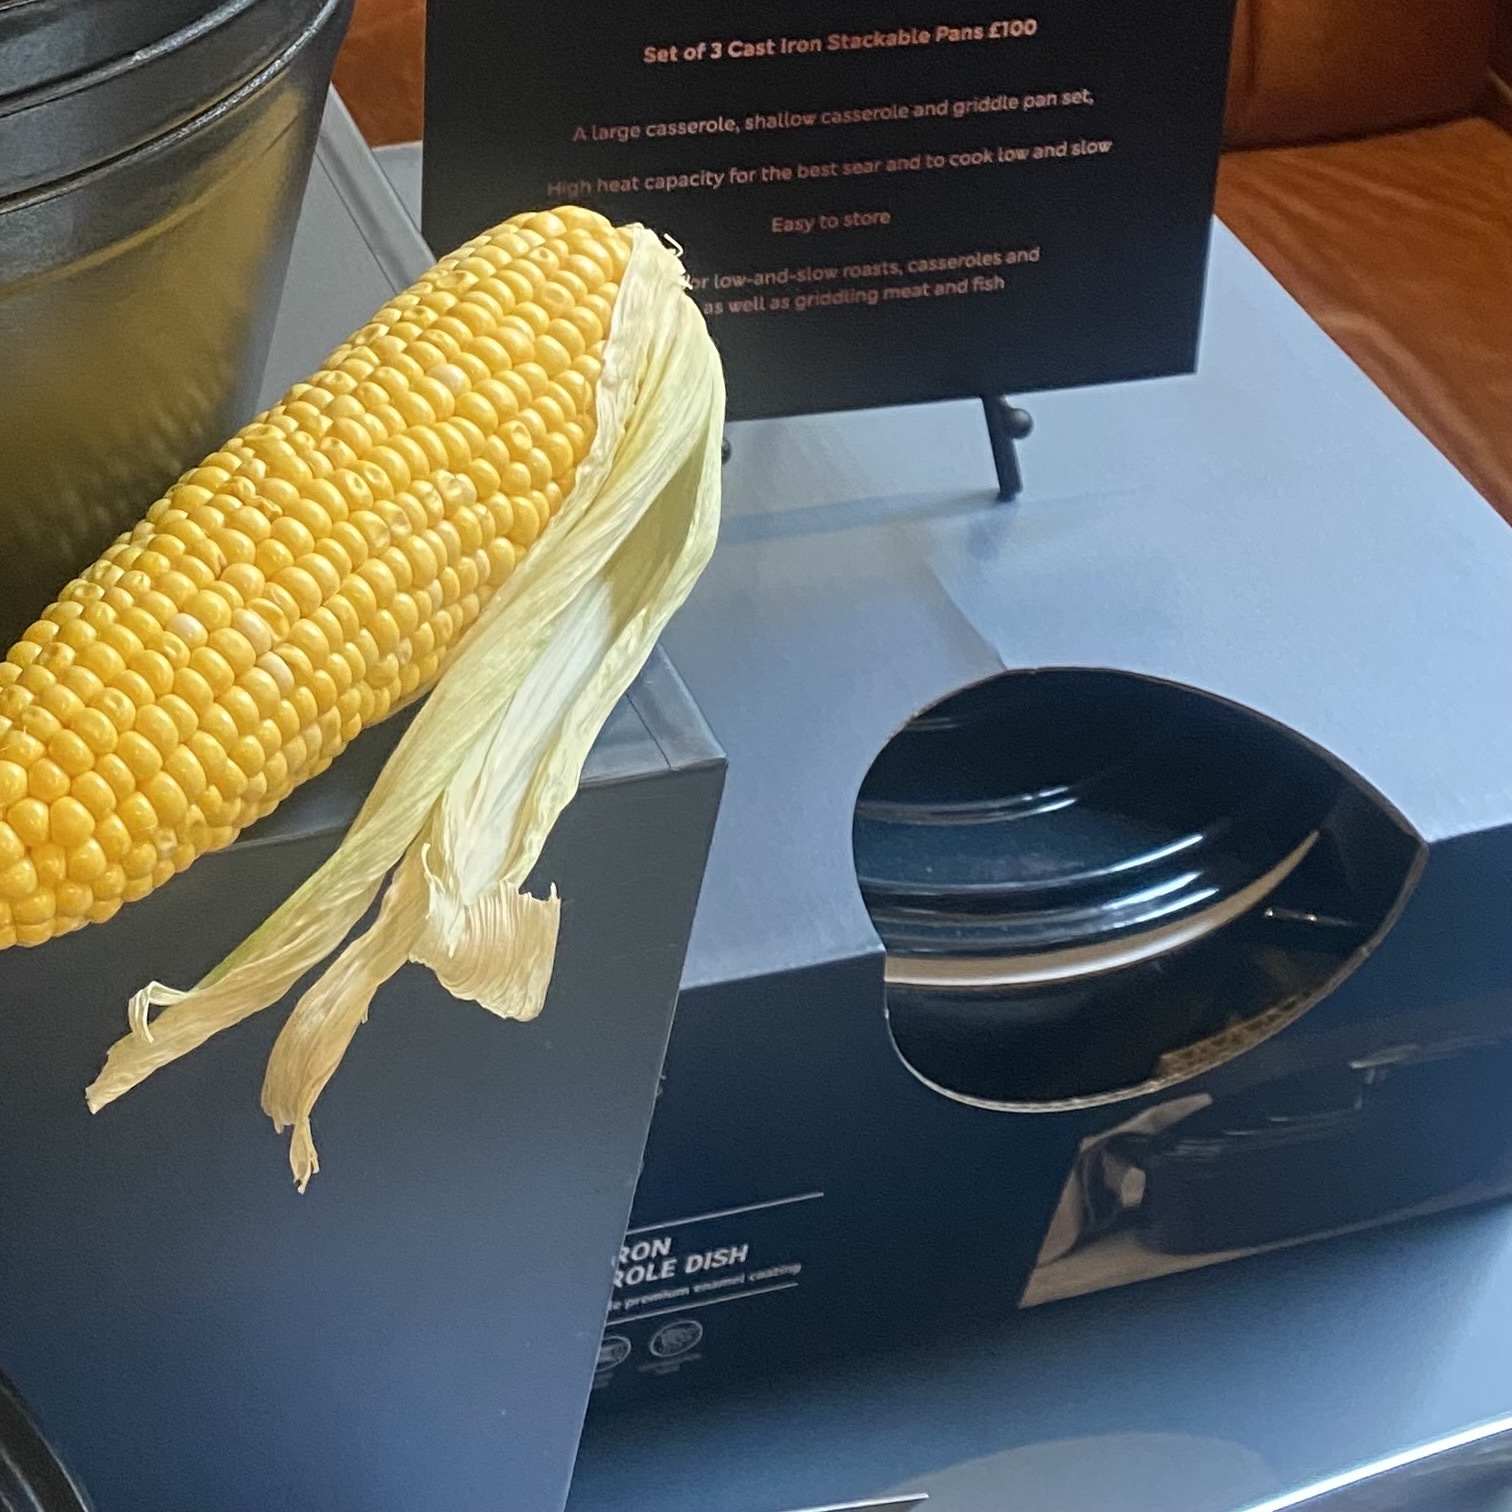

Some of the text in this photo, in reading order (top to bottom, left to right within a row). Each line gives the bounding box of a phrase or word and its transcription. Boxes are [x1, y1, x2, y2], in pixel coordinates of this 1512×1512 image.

[643, 19, 1038, 63] Set of 3 Cast Iron Stackable Pans £100
[573, 126, 587, 142] A
[592, 124, 641, 142] large
[645, 116, 740, 137] casserole,
[745, 112, 817, 131] shallow
[821, 104, 909, 125] casserole
[913, 100, 949, 117] and
[953, 94, 1019, 118] griddle
[1023, 93, 1057, 111] pan
[547, 139, 1113, 199] High heat capacity for the best sear and to cook low and slow
[771, 210, 891, 234] Easy to store
[688, 246, 1040, 290] or low-and-slow roasts, casseroles and
[703, 274, 1005, 315] as well as griddling meat and fish
[612, 1237, 672, 1266] RON
[685, 1244, 749, 1275] DISH
[624, 1286, 690, 1311] premium
